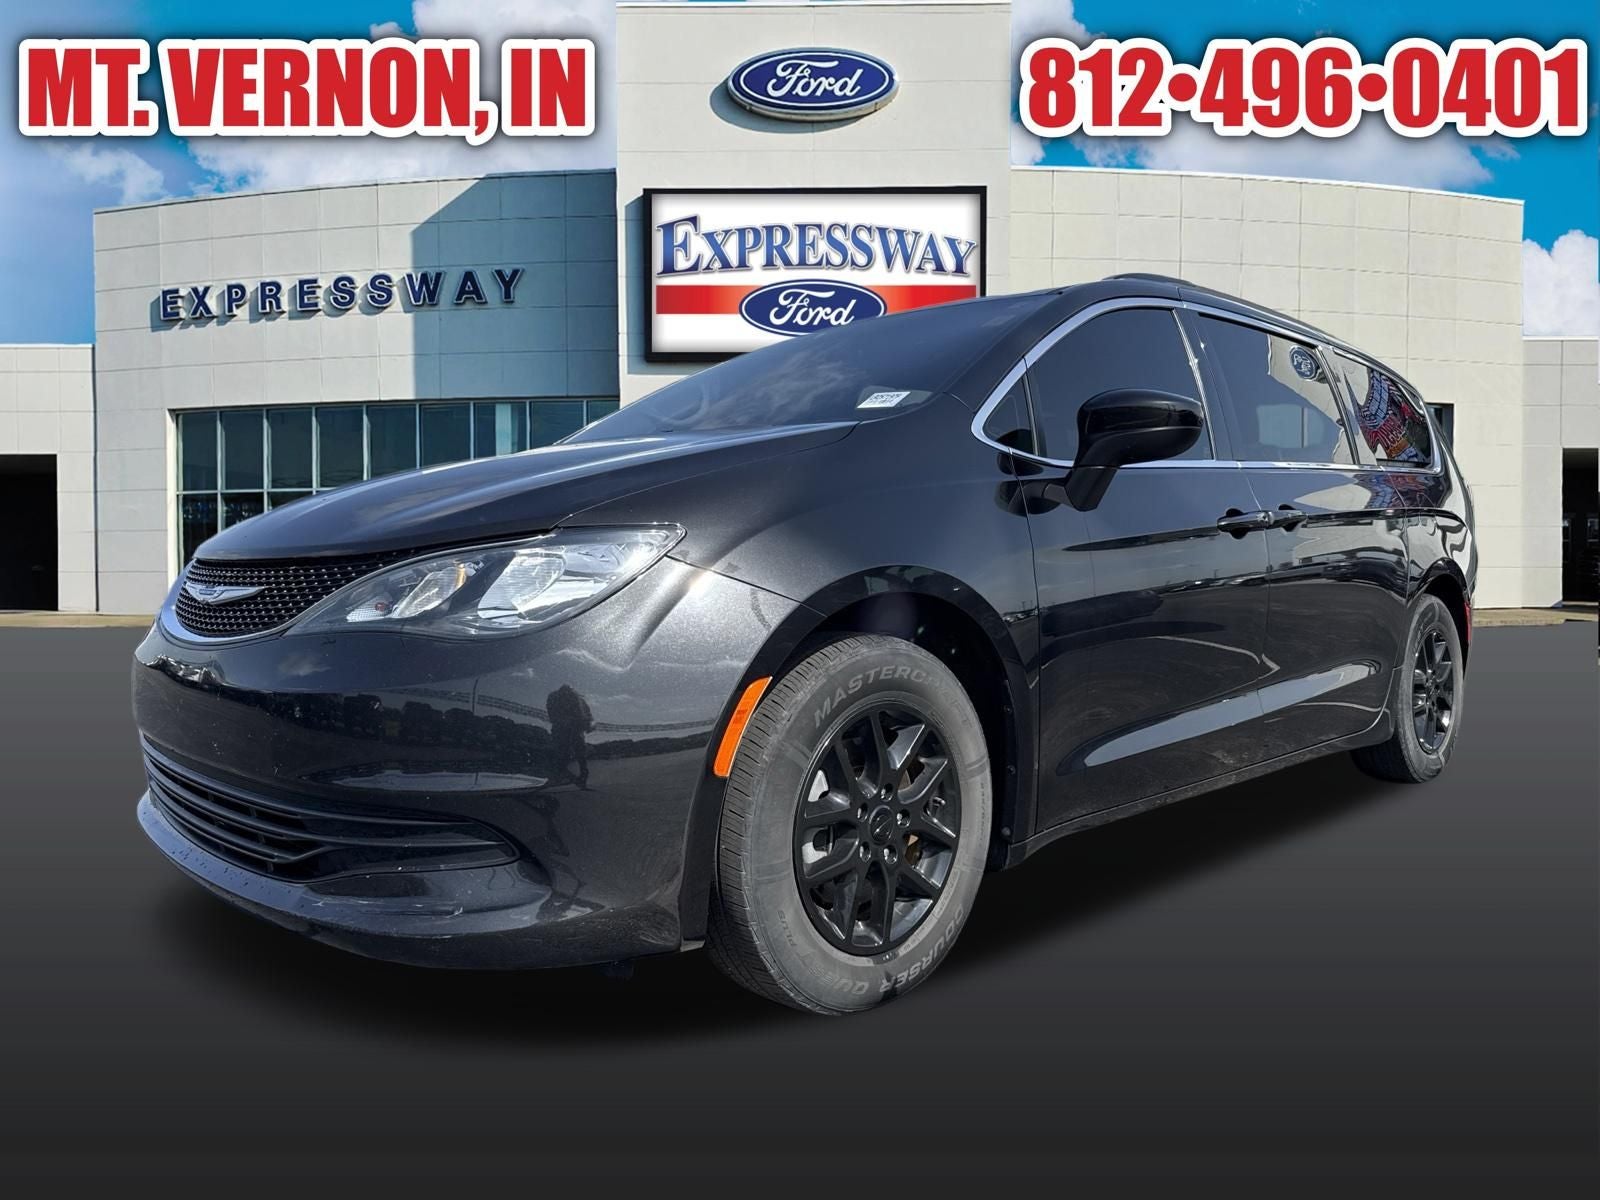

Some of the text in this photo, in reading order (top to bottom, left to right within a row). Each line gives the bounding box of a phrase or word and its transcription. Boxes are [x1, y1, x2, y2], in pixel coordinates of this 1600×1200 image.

[767, 59, 863, 98] Ford
[160, 268, 525, 321] EXPRESSWAY
[769, 289, 857, 326] Ford
